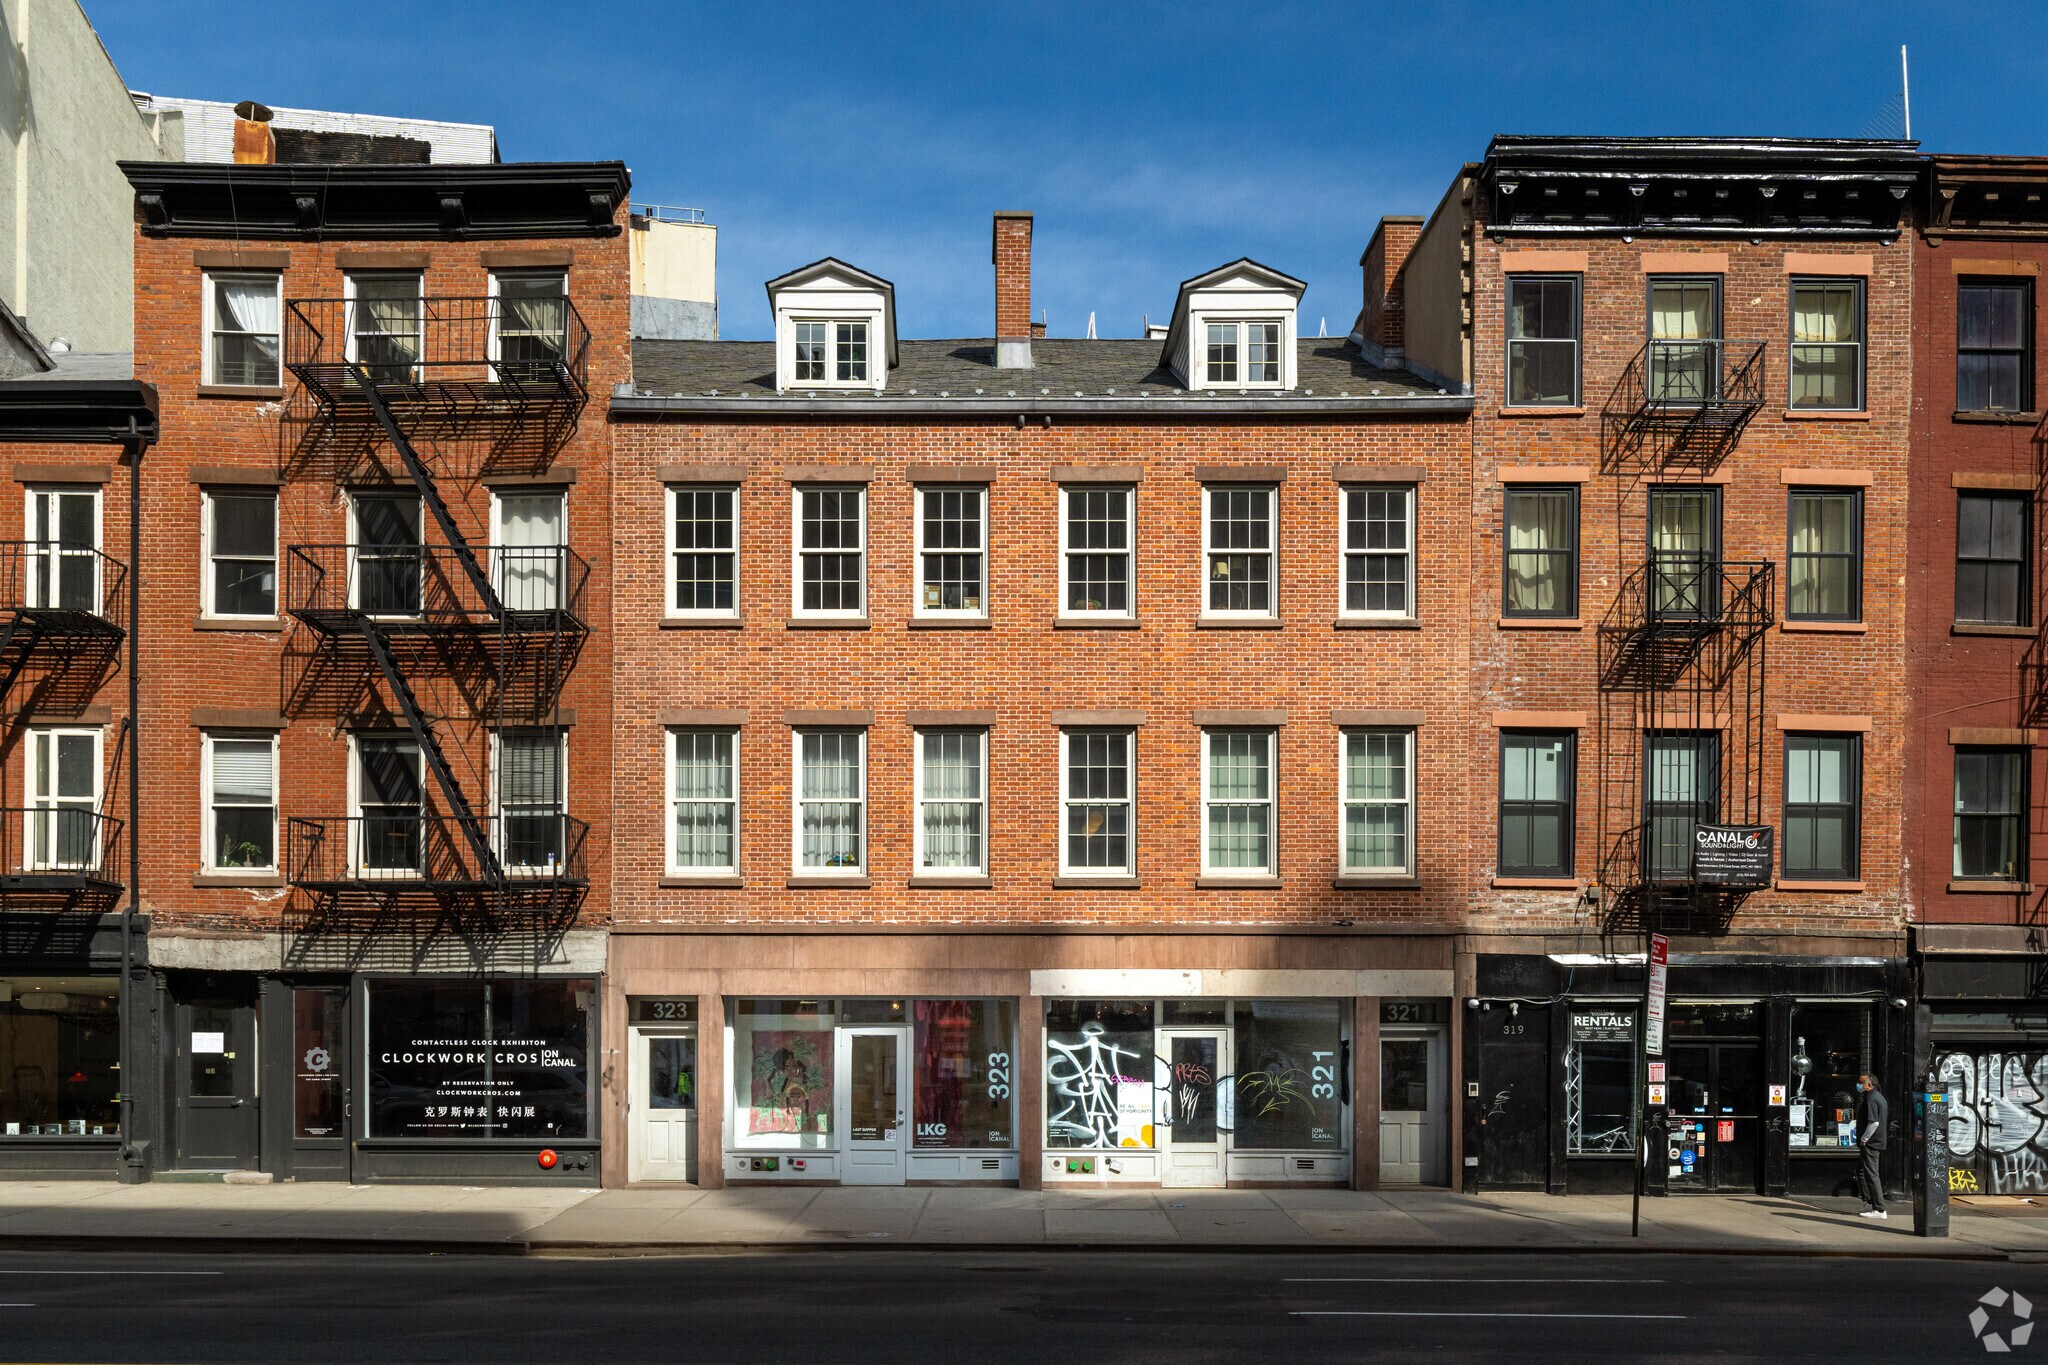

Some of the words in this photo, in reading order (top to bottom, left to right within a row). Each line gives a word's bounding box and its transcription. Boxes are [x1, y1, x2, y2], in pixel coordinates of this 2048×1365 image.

[1696, 831, 1745, 843] CANAL
[652, 1002, 688, 1019] 323
[1387, 1004, 1420, 1021] 321
[1574, 1015, 1632, 1027] RENTALS
[1503, 1025, 1525, 1035] 319
[382, 1053, 486, 1063] CLOCKWORK
[495, 1053, 538, 1063] CROS
[544, 1049, 559, 1058] ON
[544, 1058, 577, 1067] CANAL
[988, 1052, 1010, 1099] 323
[1311, 1051, 1334, 1099] 321
[916, 1123, 947, 1136] LKG
